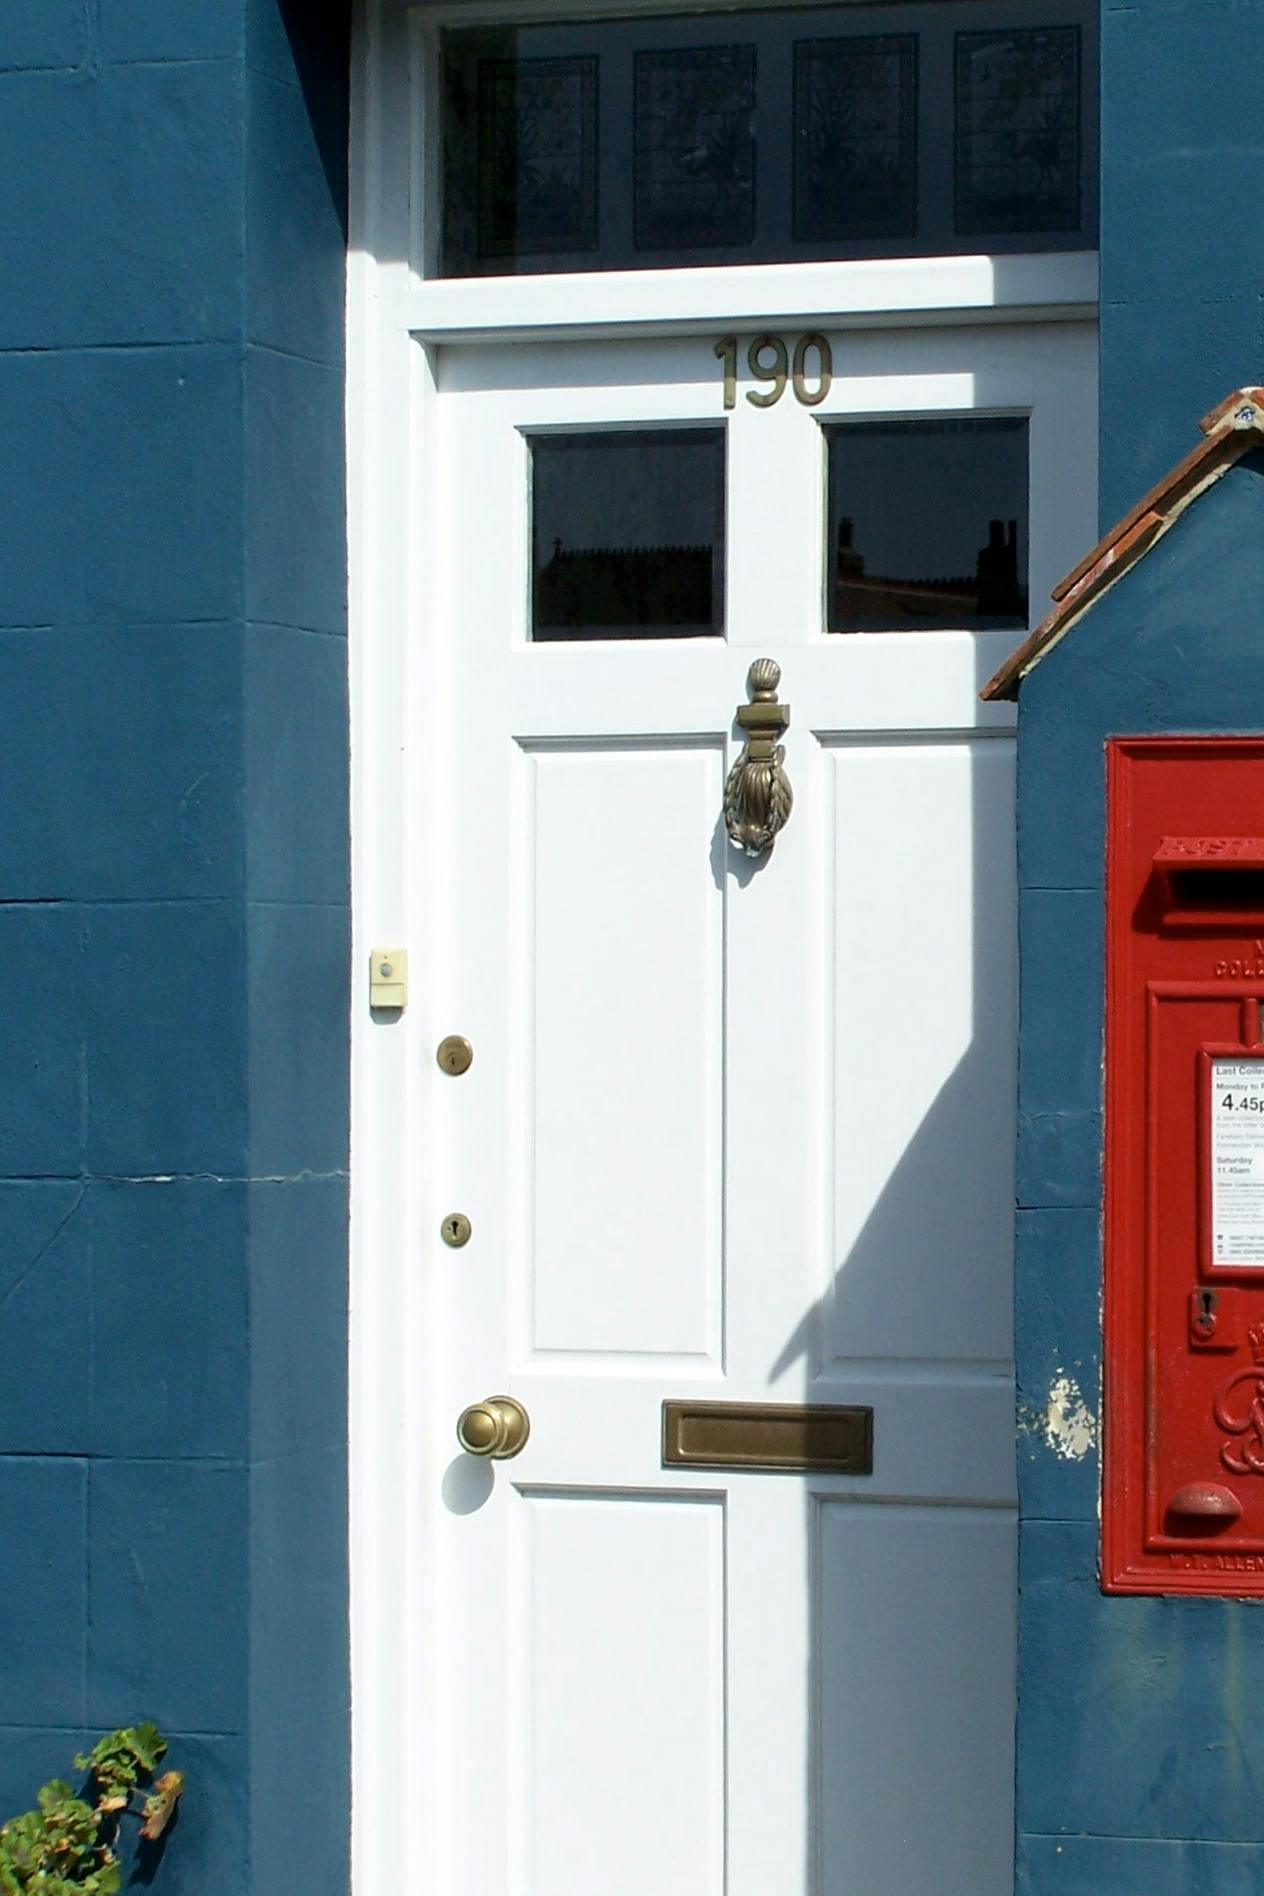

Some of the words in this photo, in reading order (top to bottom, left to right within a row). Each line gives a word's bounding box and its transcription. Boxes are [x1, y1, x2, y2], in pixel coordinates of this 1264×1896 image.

[714, 334, 832, 410] 190
[1216, 1066, 1236, 1076] Last
[1216, 1083, 1248, 1091] Monday
[1216, 1157, 1253, 1165] Saturday
